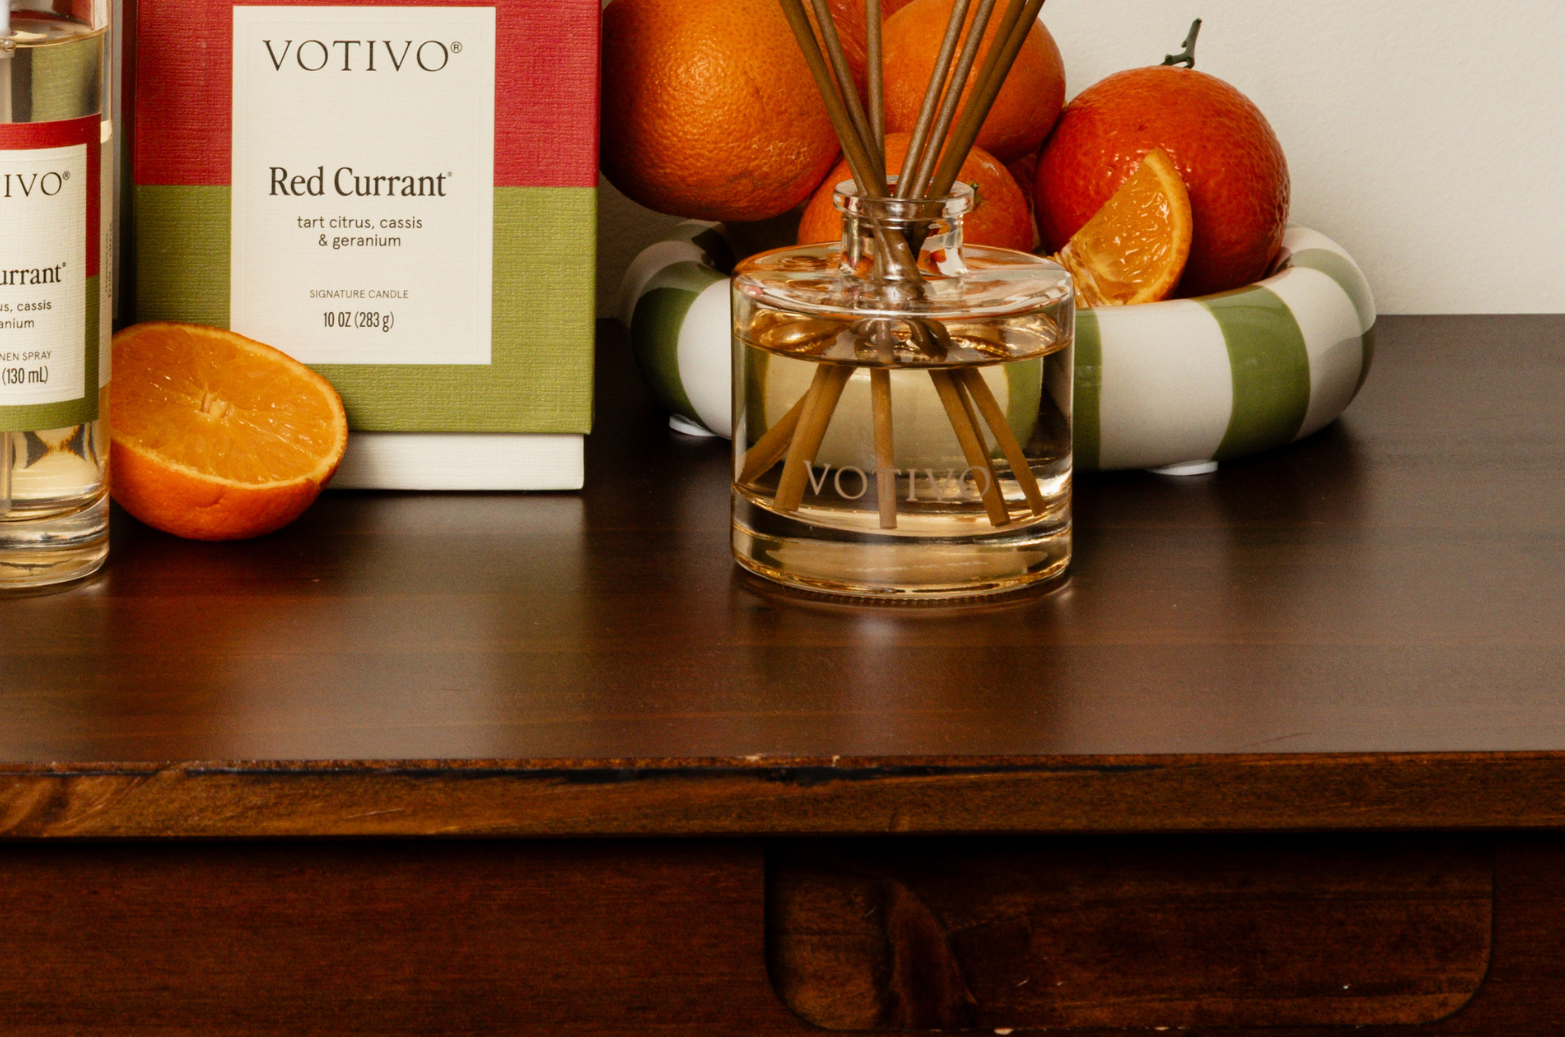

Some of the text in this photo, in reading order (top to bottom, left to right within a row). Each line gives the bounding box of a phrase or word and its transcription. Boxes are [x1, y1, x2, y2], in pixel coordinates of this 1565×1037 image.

[268, 165, 326, 197] Red
[296, 214, 423, 231] tart citrus, cassis
[318, 233, 401, 251] & geranium
[309, 288, 409, 299] SIGNATURE CANDLE
[16, 299, 52, 312] cassis
[323, 311, 395, 333] 10 OZ (283 g)
[22, 350, 52, 362] SPRAY
[1, 366, 26, 386] (130
[28, 365, 49, 385] mL)
[803, 459, 993, 503] VOTIVO
